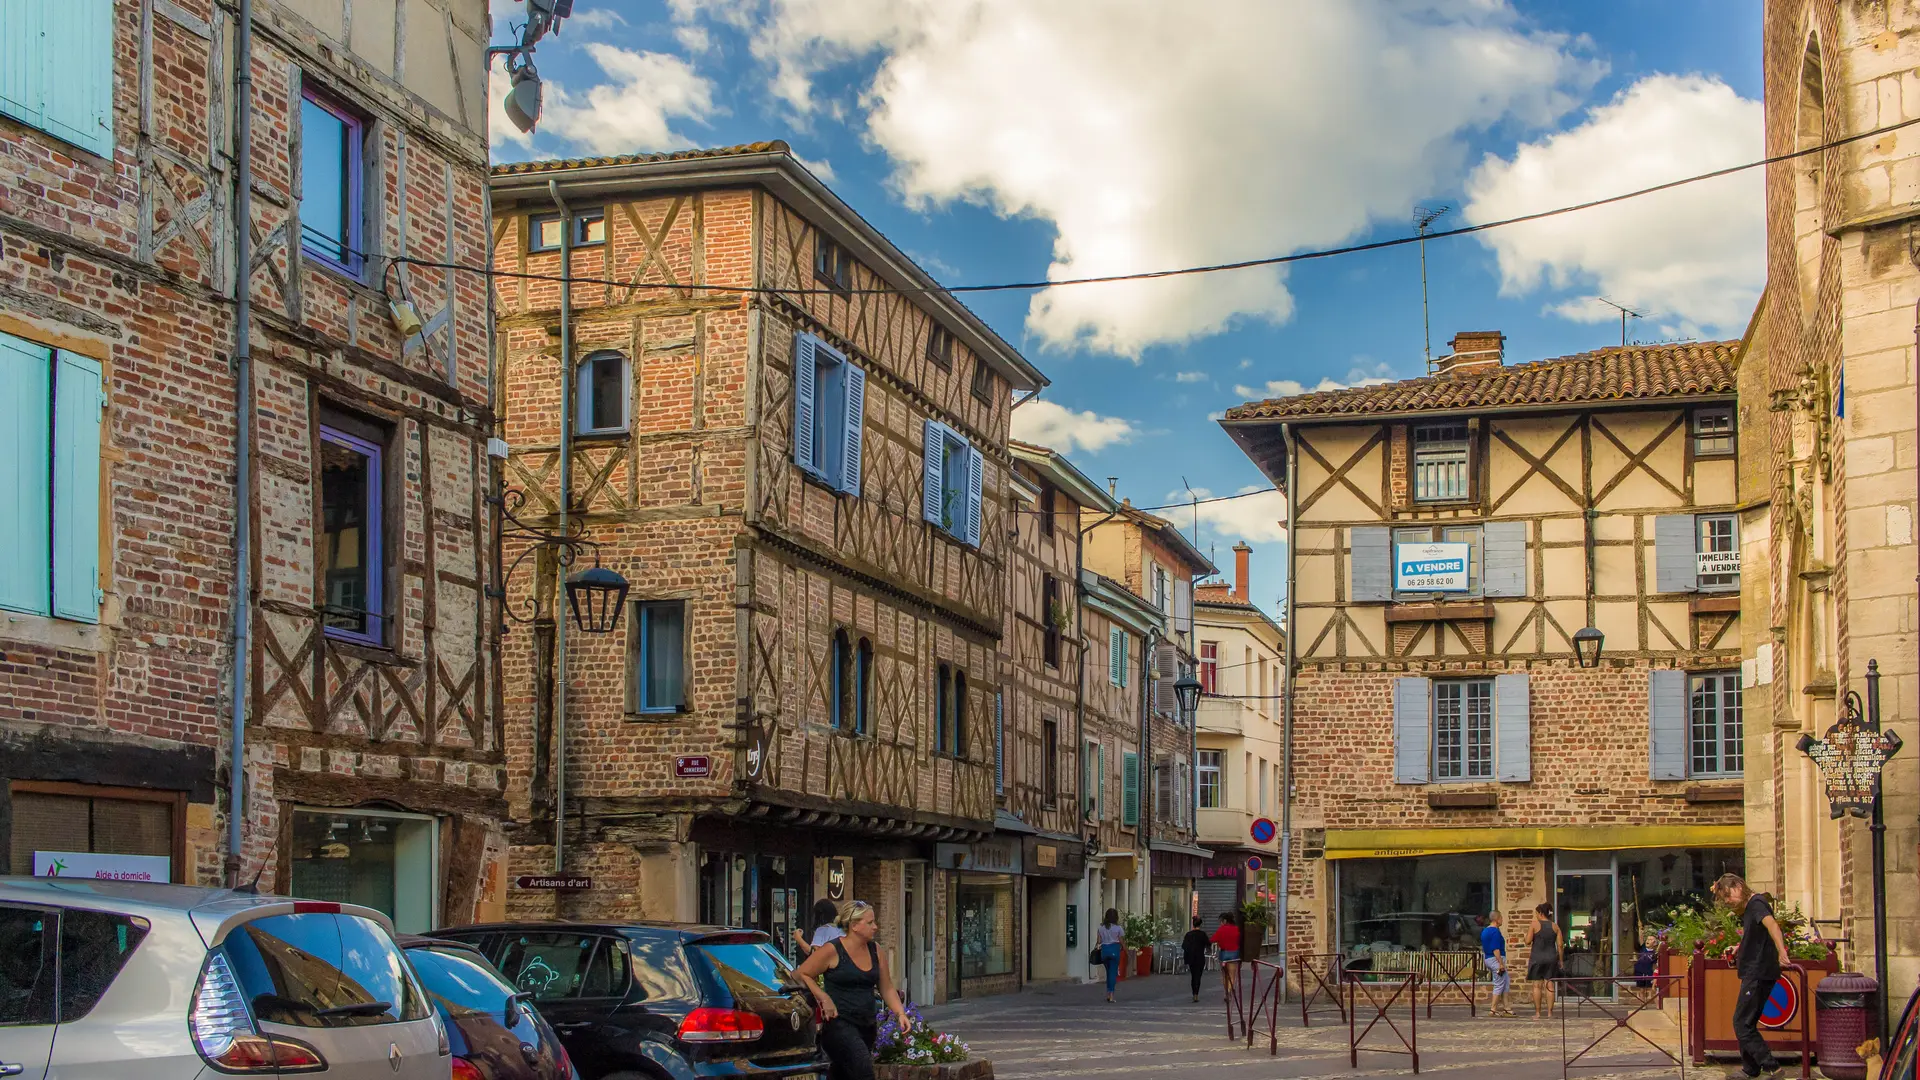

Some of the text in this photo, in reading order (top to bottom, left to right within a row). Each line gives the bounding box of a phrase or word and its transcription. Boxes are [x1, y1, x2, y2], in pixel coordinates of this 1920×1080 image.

[1699, 553, 1740, 562] IMMEUBLE
[1406, 562, 1460, 573] A VENDRE
[1711, 564, 1740, 572] VENDRE
[95, 870, 151, 880] Aide à domicile
[529, 879, 589, 887] Artisans d'art
